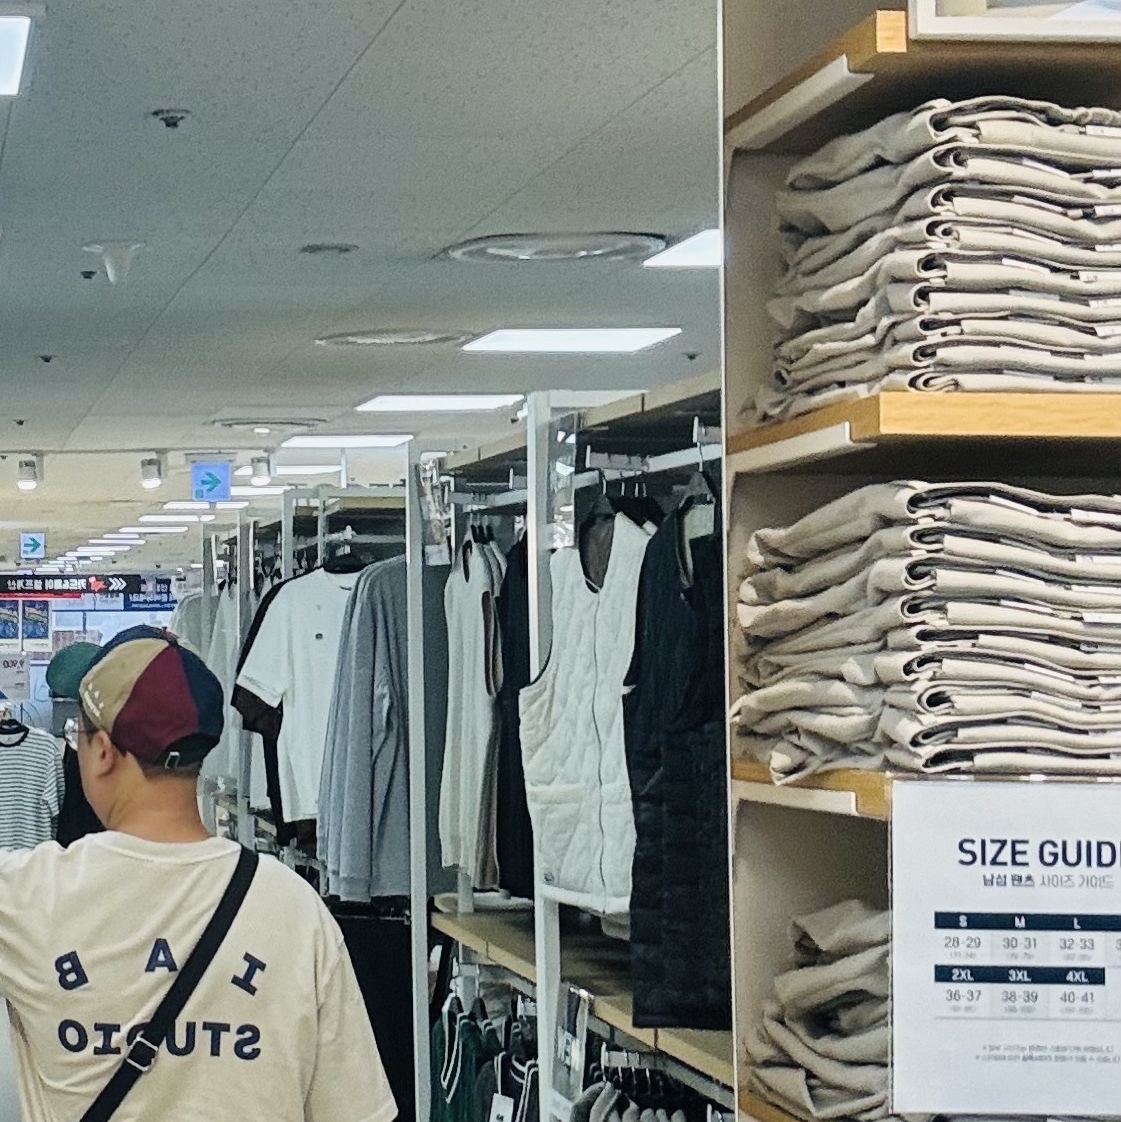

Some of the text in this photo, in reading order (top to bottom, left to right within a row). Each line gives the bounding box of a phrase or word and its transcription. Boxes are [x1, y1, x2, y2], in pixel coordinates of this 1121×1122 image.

[958, 838, 1121, 868] SIZE GUID
[1039, 874, 1076, 889] 사이즈
[1078, 874, 1115, 889] 가이드
[958, 914, 1082, 930] S M L
[1002, 937, 1038, 950] 30-31
[1059, 938, 1095, 951] 32-33
[951, 968, 1089, 983] 2XL 3XL 4XL
[945, 988, 1095, 1004] 36-37 38-39 40-41
